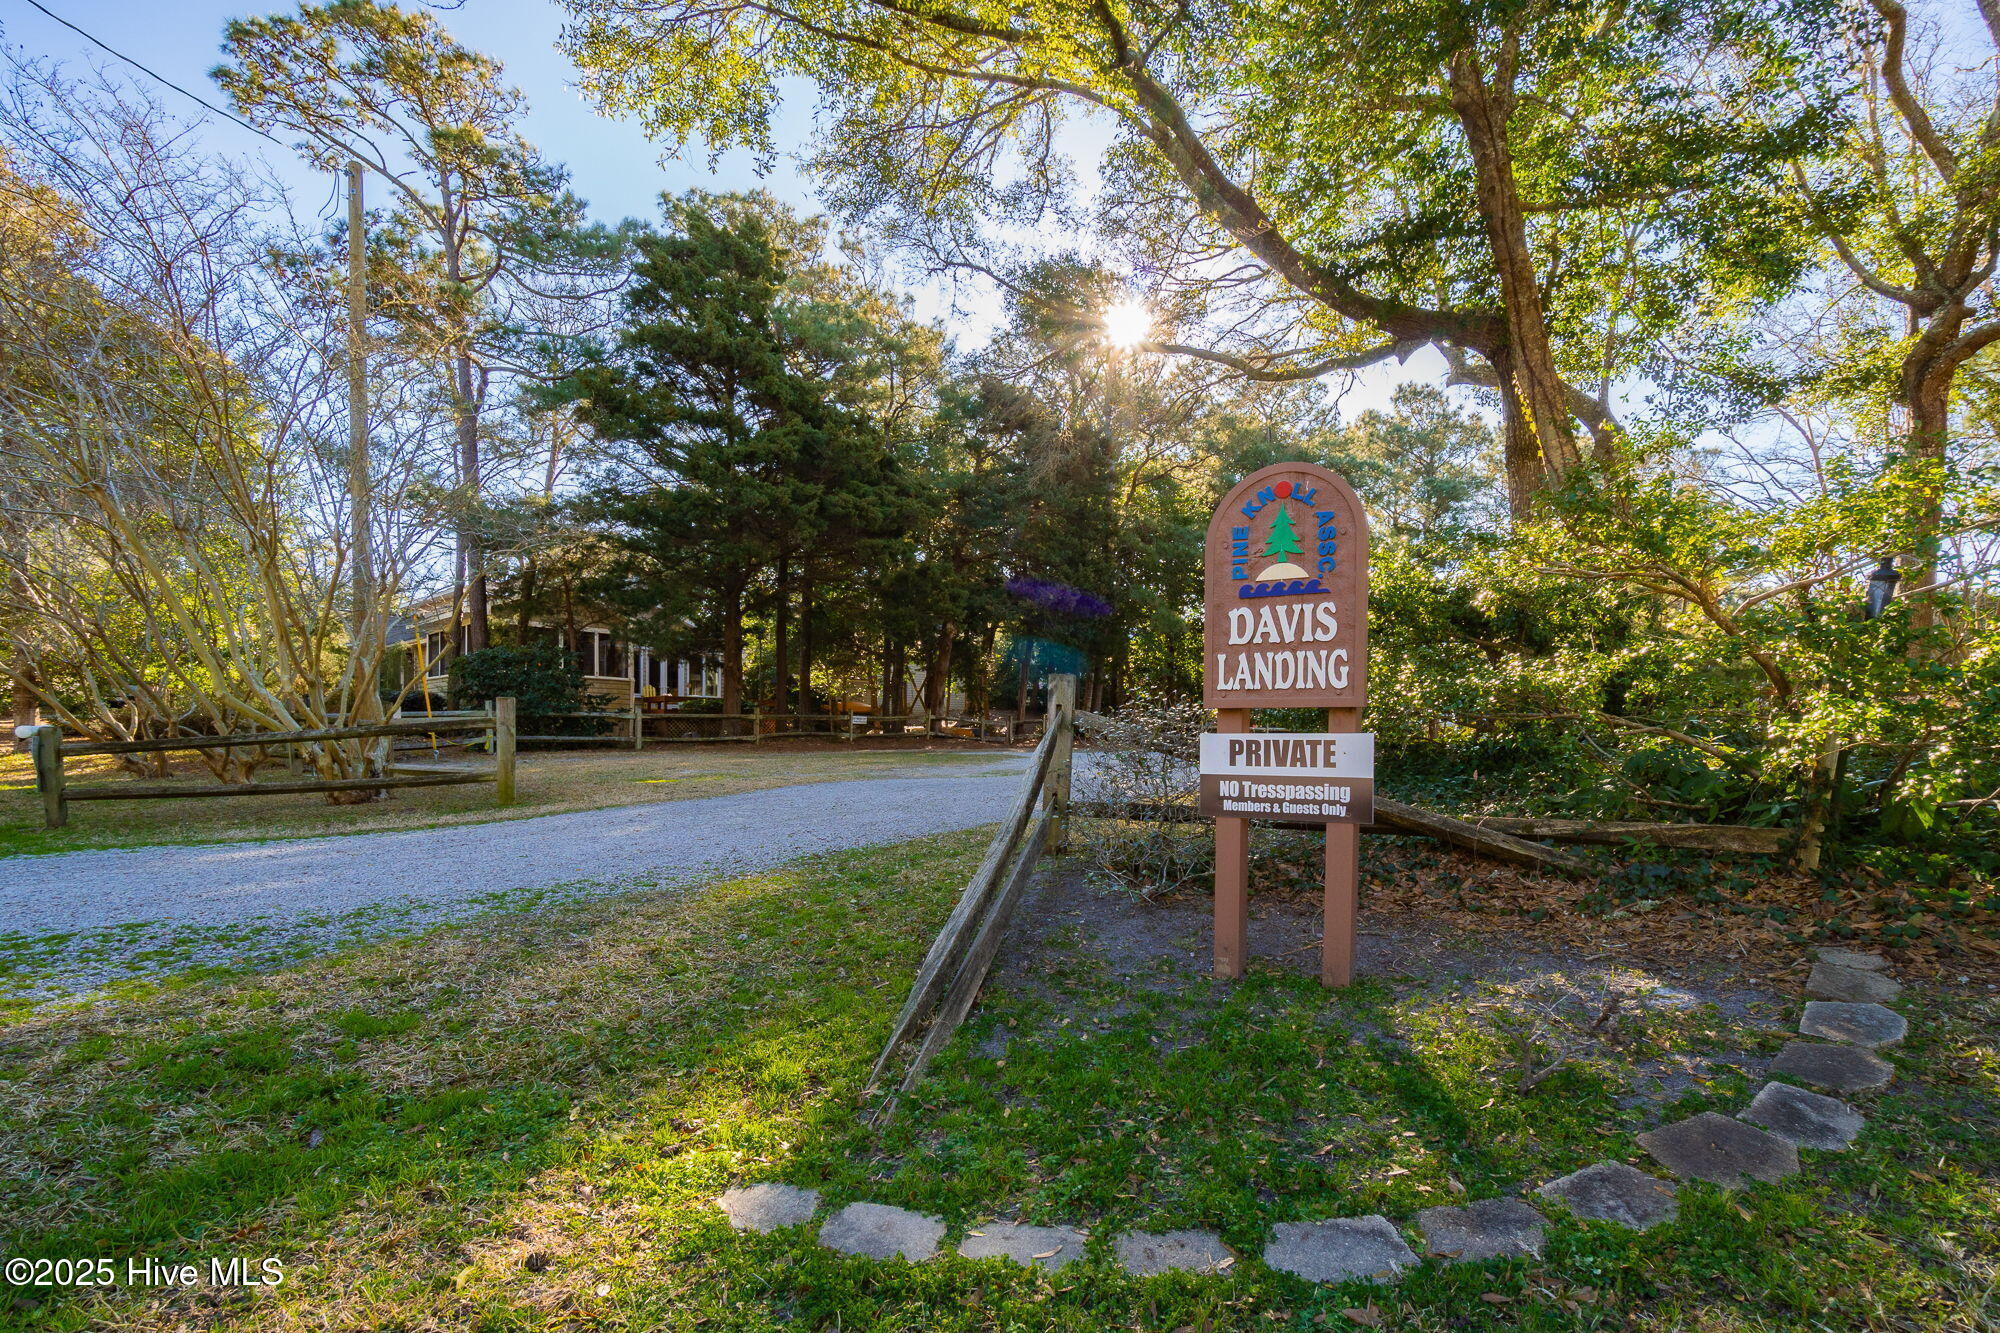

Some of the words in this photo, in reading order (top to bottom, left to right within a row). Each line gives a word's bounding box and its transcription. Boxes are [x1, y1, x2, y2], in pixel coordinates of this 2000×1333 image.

[1231, 525, 1250, 580] PINE
[1241, 480, 1317, 519] KNOLL
[1315, 510, 1338, 579] ASSC.
[1228, 601, 1338, 645] DAVIS
[1216, 649, 1350, 690] LANDING
[1229, 739, 1337, 768] PRIVATE
[1219, 780, 1240, 798] NO
[1242, 780, 1351, 804] Tresspassing
[1223, 799, 1272, 813] Members
[1272, 802, 1281, 813] &
[1282, 801, 1320, 815] Guests
[1321, 802, 1347, 818] Only
